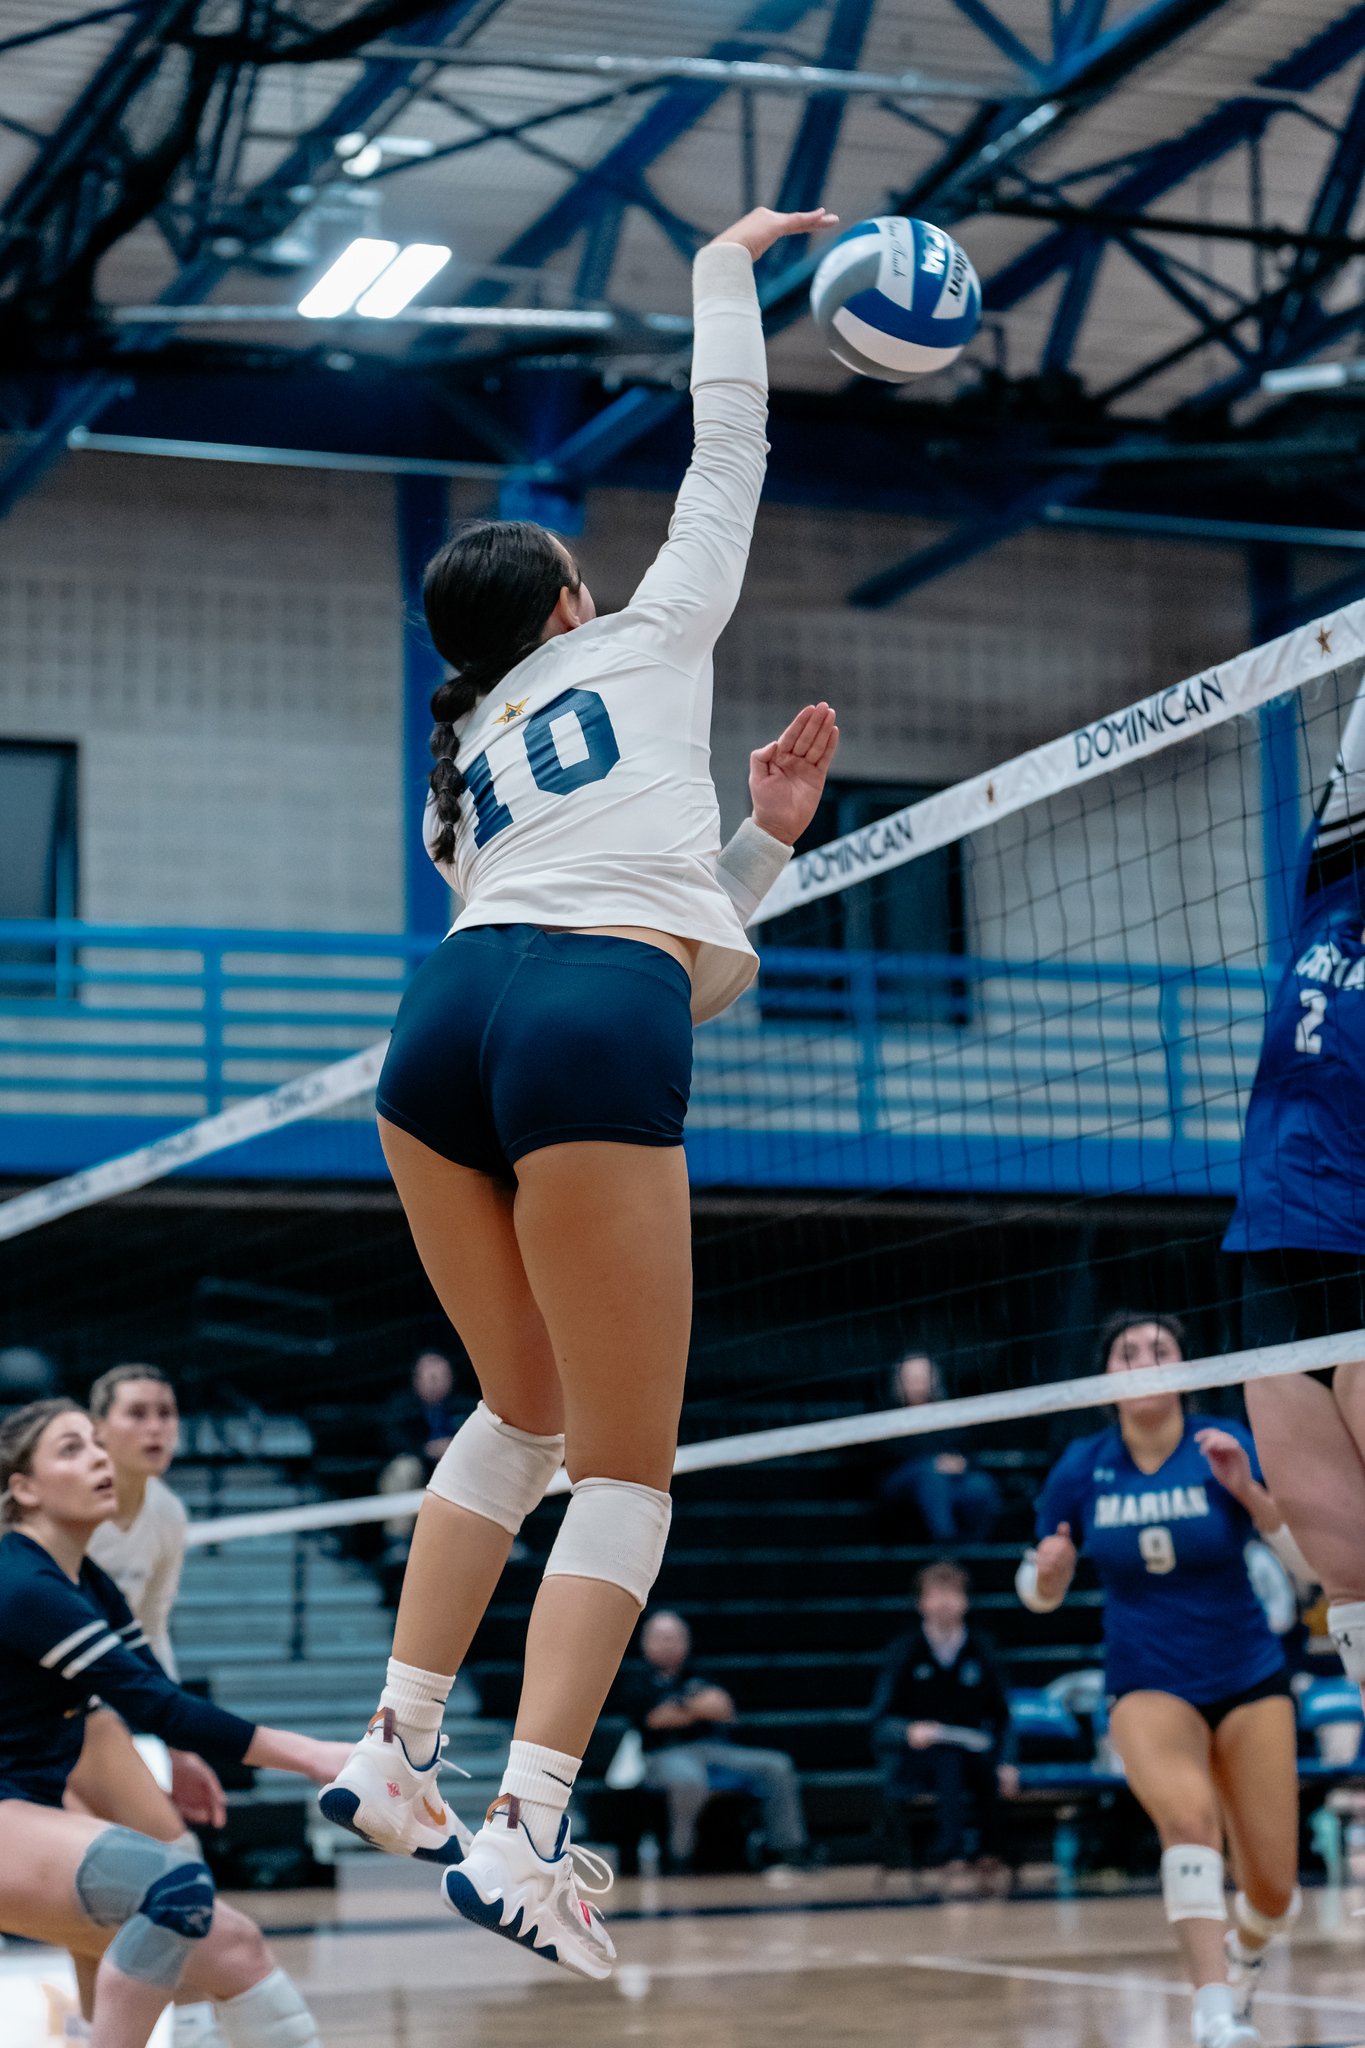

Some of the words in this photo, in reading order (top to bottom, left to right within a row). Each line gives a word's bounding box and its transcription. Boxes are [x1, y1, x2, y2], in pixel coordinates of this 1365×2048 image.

[1074, 670, 1227, 769] DOMINICAN
[462, 687, 620, 850] 10
[797, 814, 914, 891] DOMINICAN
[1295, 988, 1328, 1055] 2
[1138, 1526, 1176, 1575] 9
